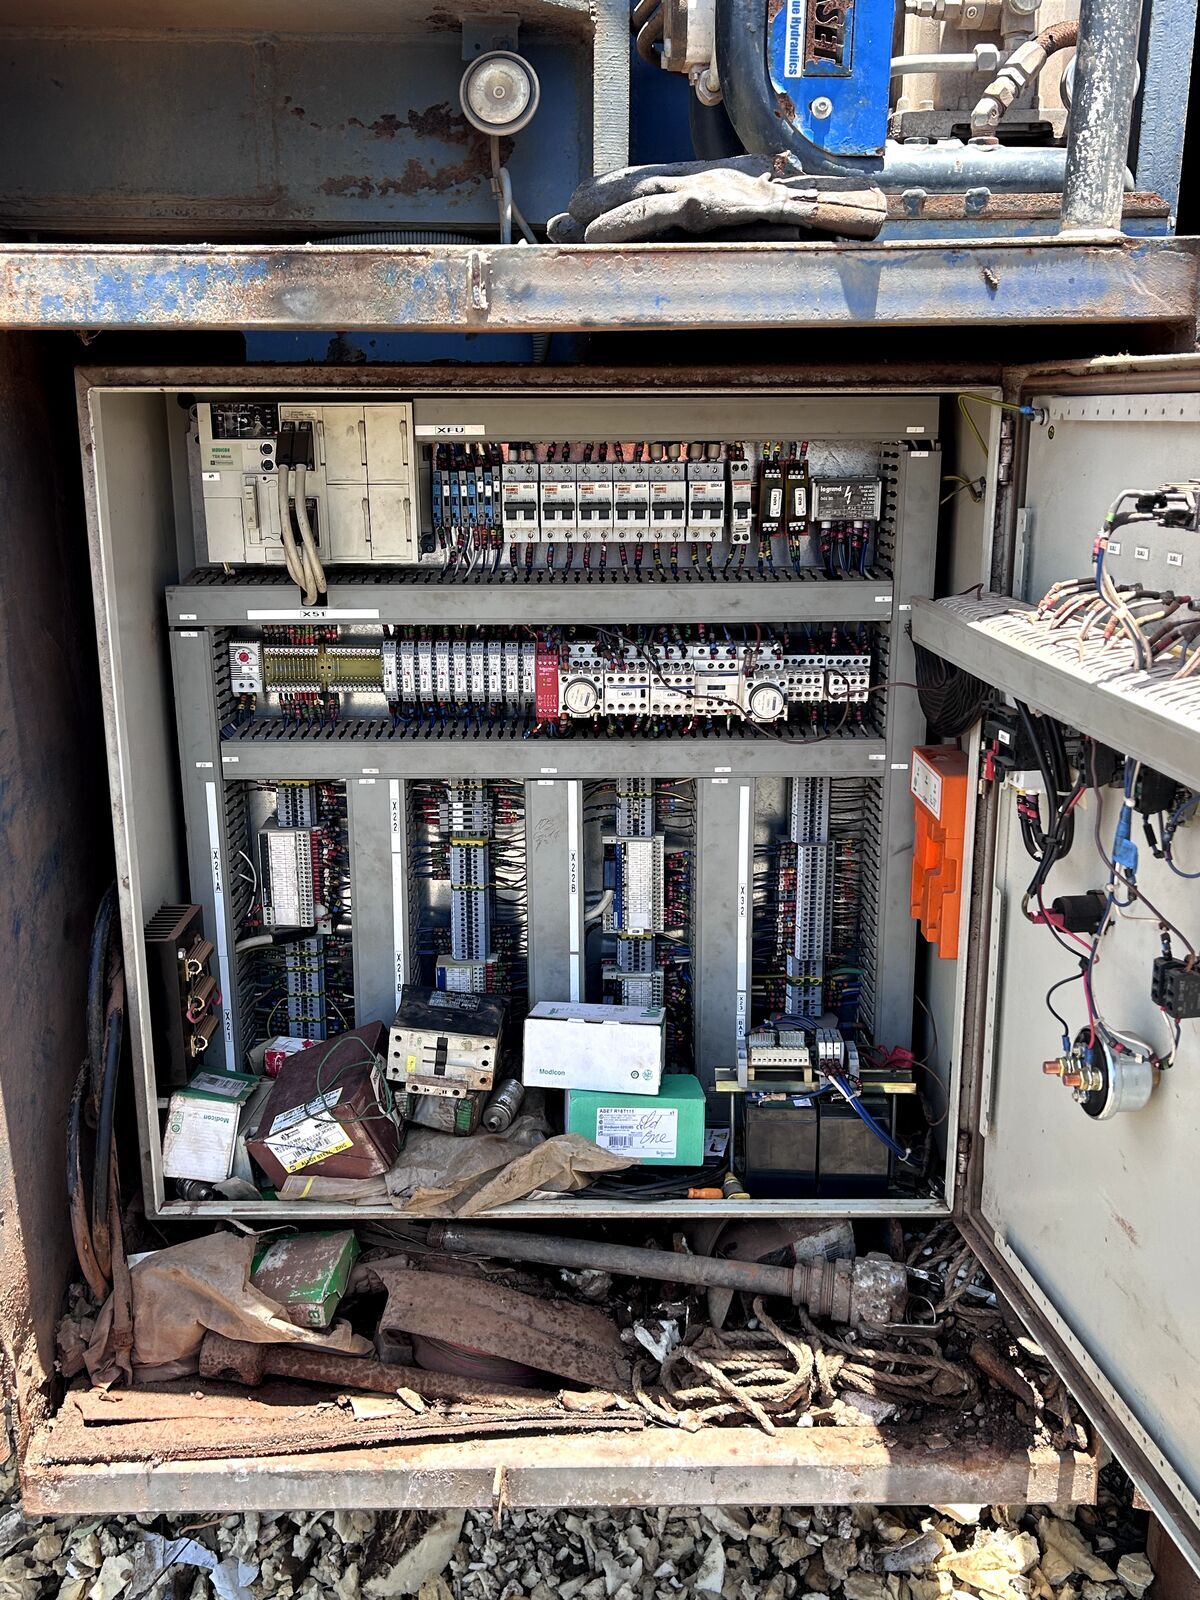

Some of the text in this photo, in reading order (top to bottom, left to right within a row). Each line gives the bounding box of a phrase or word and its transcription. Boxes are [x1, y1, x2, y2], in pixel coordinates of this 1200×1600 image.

[789, 16, 802, 75] Hydraulics
[437, 426, 465, 435] XFU
[820, 485, 842, 493] legrand
[301, 609, 326, 618] X51
[212, 850, 222, 892] X21A
[395, 952, 403, 991] X21B
[538, 1068, 566, 1077] Modicon
[203, 1114, 230, 1124] Modicon
[640, 1131, 673, 1145] One
